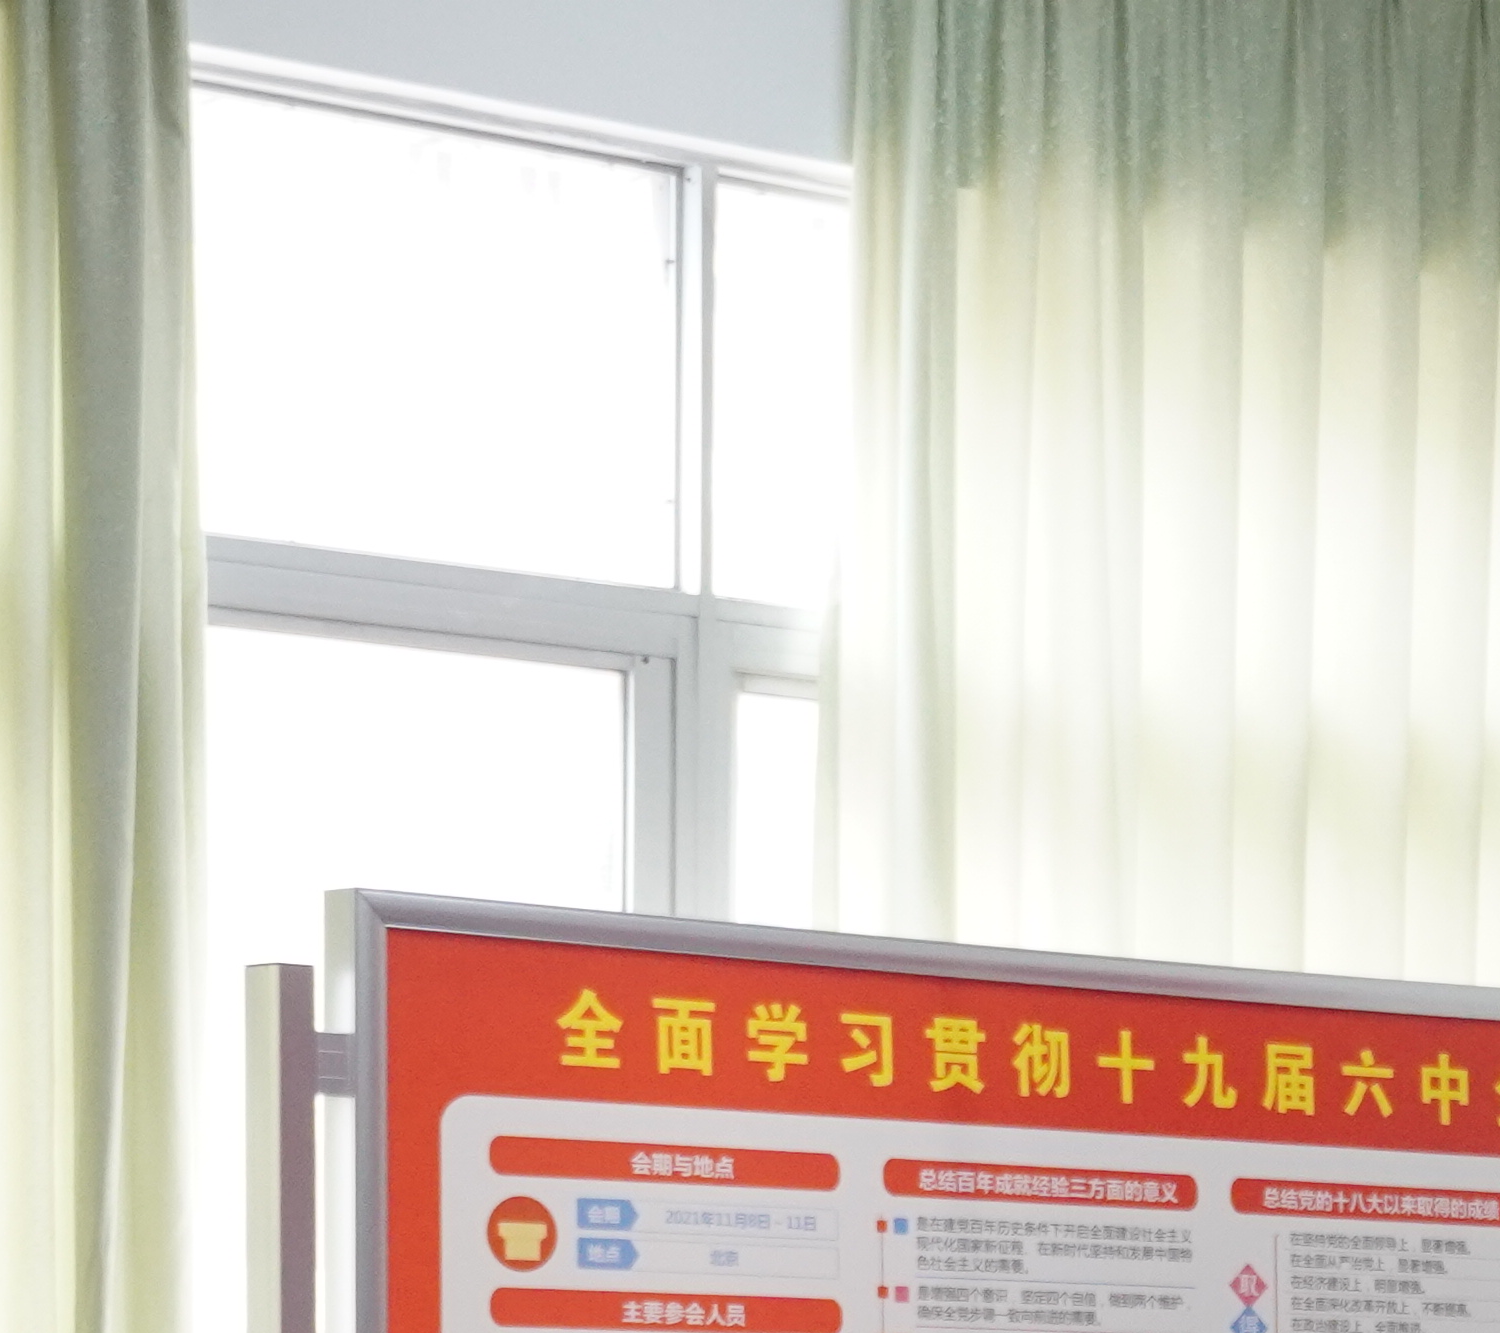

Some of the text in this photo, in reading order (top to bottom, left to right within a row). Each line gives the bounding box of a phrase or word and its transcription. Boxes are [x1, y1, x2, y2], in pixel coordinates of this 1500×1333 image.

[630, 1152, 735, 1180] 会期与地点
[919, 1168, 1179, 1203] 总结百年成就经验三方面的意义
[1264, 1187, 1500, 1222] 总结党的十八大以来取得的成绩
[622, 1301, 746, 1326] 主要参会人员
